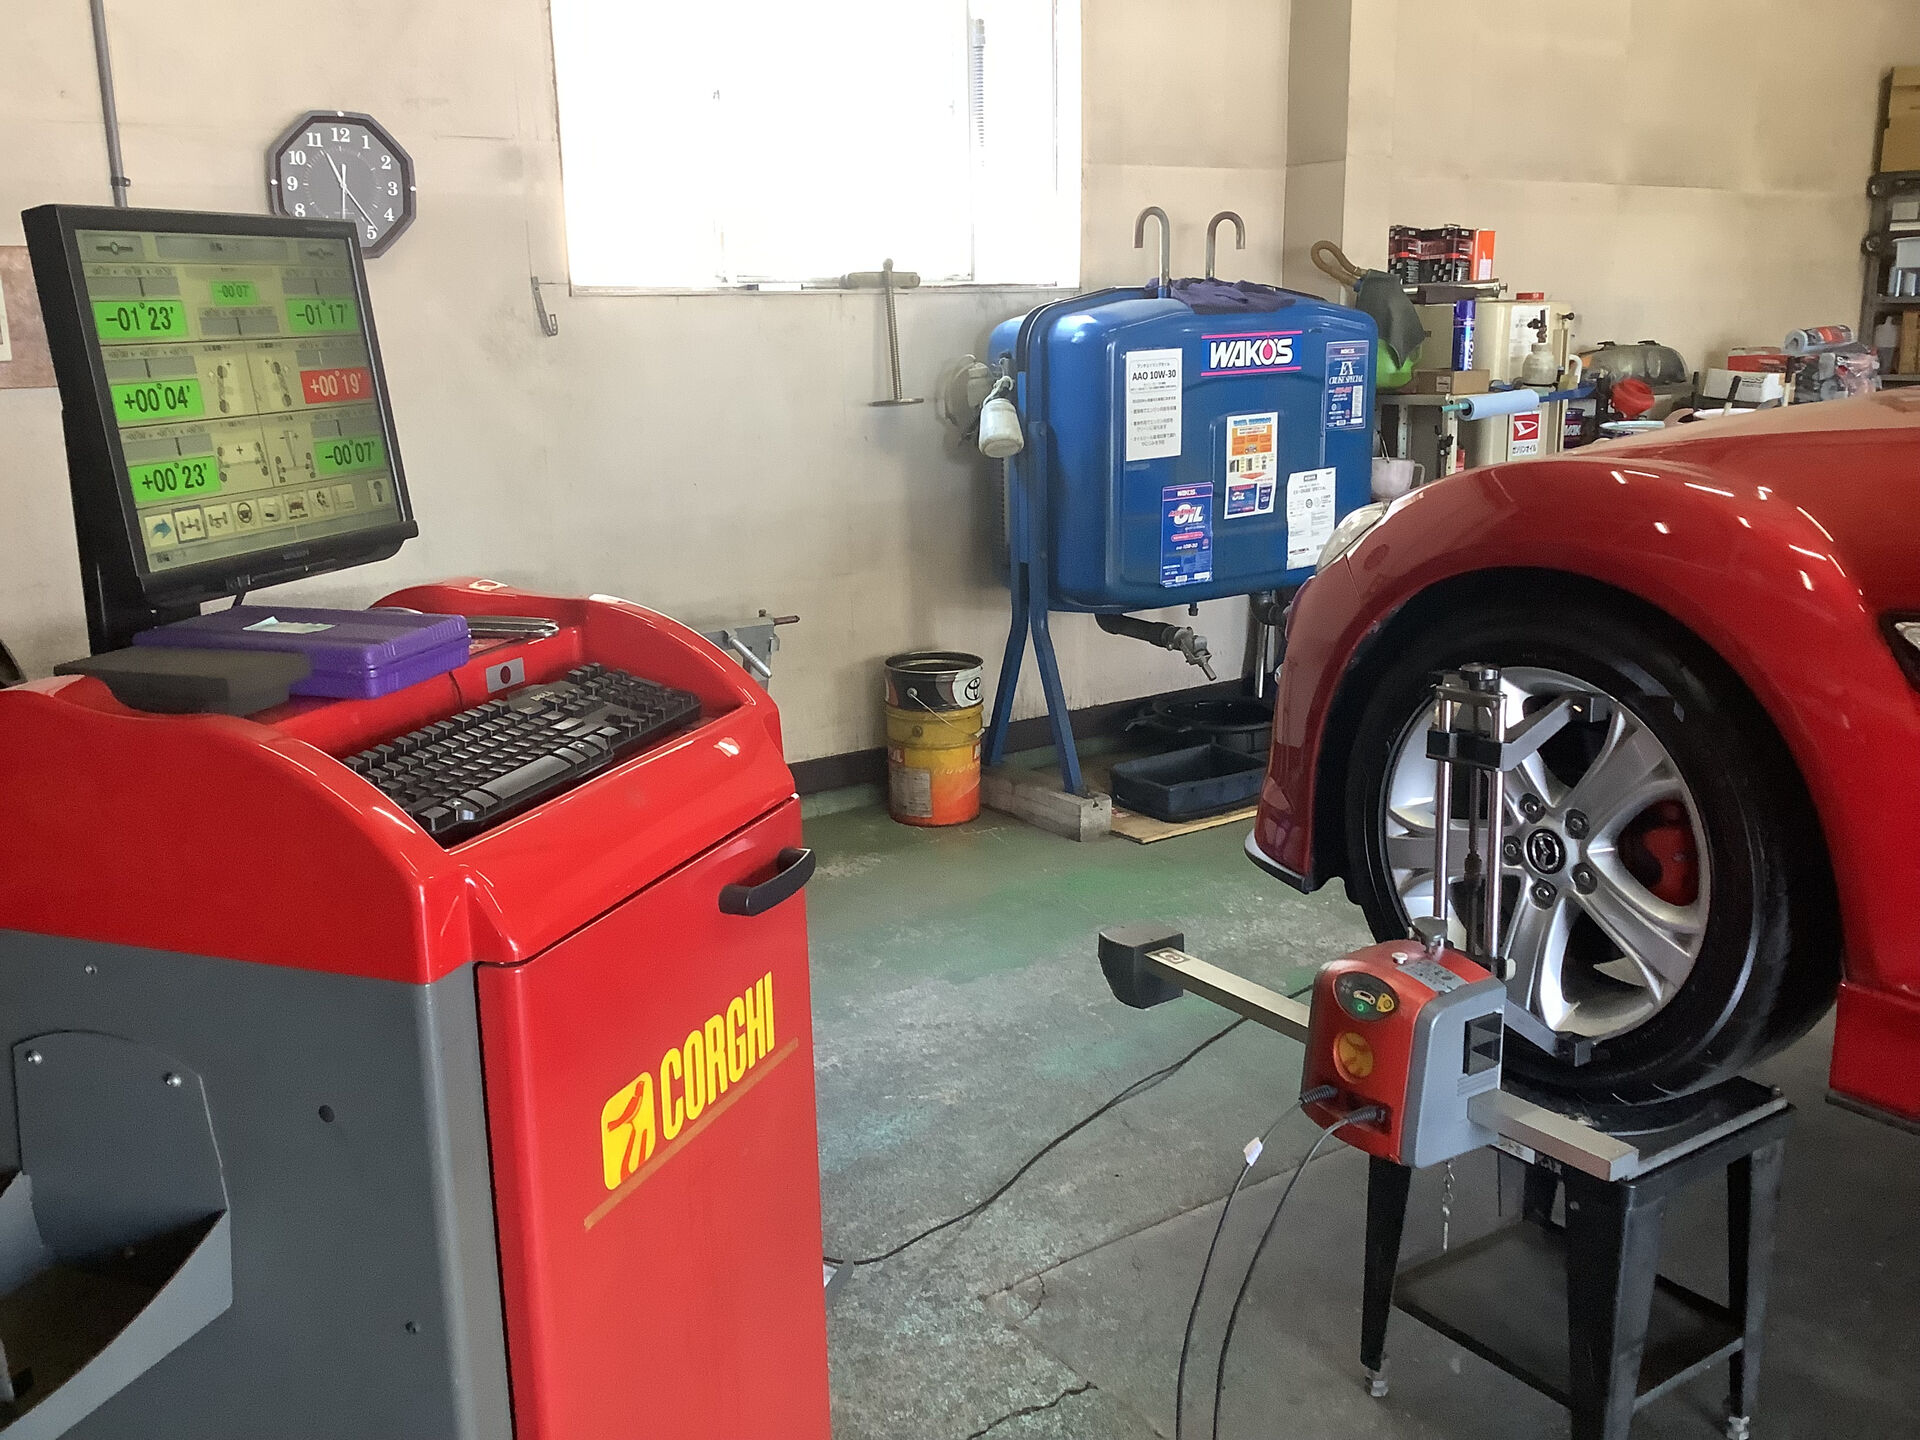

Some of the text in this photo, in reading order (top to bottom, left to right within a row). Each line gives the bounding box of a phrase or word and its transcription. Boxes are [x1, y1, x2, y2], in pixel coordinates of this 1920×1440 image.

[306, 132, 324, 148] 11
[331, 127, 351, 143] 12
[362, 135, 371, 150] 1
[288, 150, 307, 166] 10
[380, 155, 392, 170] 2
[286, 176, 298, 191] 9
[387, 181, 398, 196] 3
[294, 203, 306, 218] 8
[383, 207, 395, 222] 4
[366, 225, 377, 240] 5
[1210, 337, 1294, 369] WAKO'S
[1132, 369, 1177, 381] AAO 10W-30
[660, 970, 776, 1141] CORGHI
